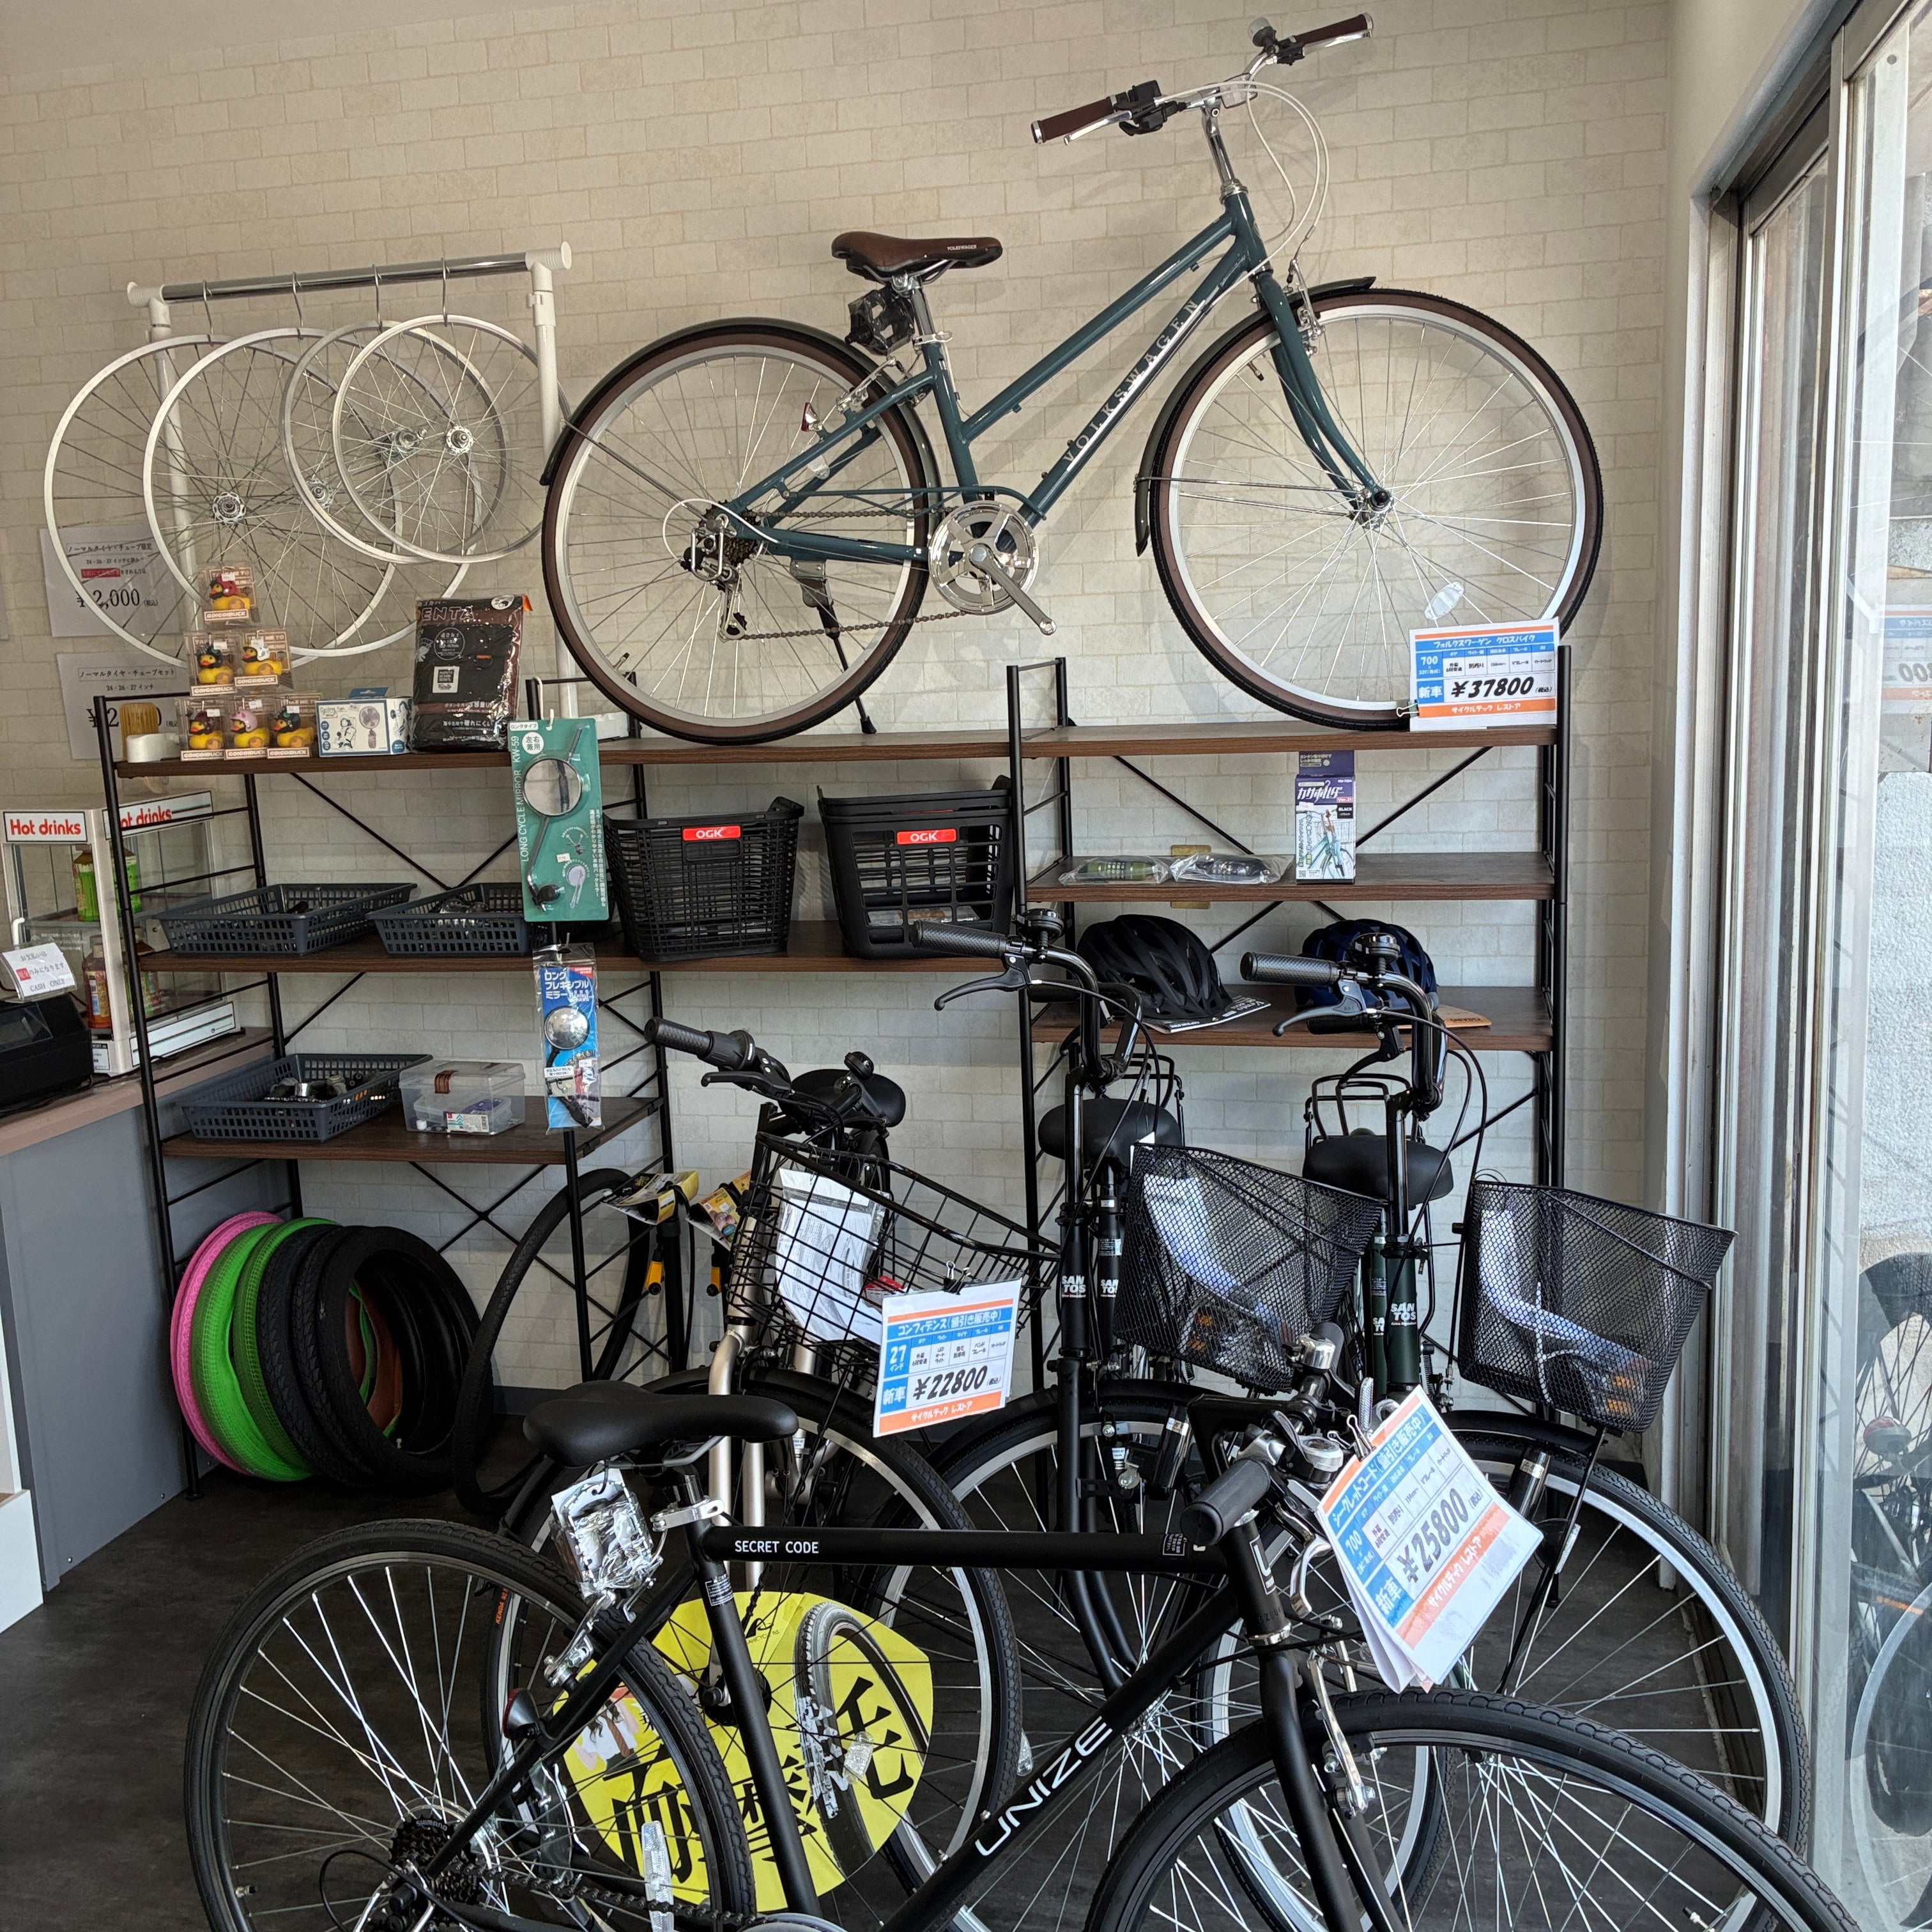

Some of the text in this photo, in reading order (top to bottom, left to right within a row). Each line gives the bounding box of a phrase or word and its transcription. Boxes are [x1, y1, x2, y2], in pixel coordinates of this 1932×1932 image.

[1433, 634, 1535, 649] フォルクスワーゲン クロスバイク
[1420, 656, 1438, 665] 700
[1418, 686, 1443, 698] 新車
[1451, 676, 1535, 698] ¥37800
[1451, 702, 1521, 714] サイクルテック レストア
[526, 743, 541, 751] 兼用
[512, 735, 530, 862] LONG CYCLE MIRROR KW-59
[121, 811, 133, 828] ot
[10, 818, 81, 836] Hot drinks
[695, 828, 724, 839] OGK
[910, 831, 939, 843] OGK
[544, 970, 567, 981] ロング
[30, 978, 66, 992] CASH ONLY
[544, 979, 589, 990] フレキシブル
[545, 990, 568, 1000] ミラー
[1061, 1275, 1085, 1285] SAN
[1063, 1284, 1086, 1294] TOS
[1390, 1302, 1415, 1312] SAN
[1373, 1317, 1384, 1325] SA
[1393, 1312, 1416, 1321] TOS
[889, 1344, 907, 1365] 27
[889, 1363, 905, 1372] インチ
[912, 1365, 988, 1400] ¥22800
[882, 1385, 907, 1406] 新車
[911, 1400, 974, 1422] サイクルテック レストア
[1345, 1528, 1363, 1554] 700
[1396, 1487, 1469, 1584] ¥25800
[735, 1540, 819, 1554] SECRET CODE
[1427, 1536, 1483, 1609] サイクルテック レストア
[1374, 1578, 1402, 1614] 新車
[974, 1715, 1113, 1856] UNIZE
